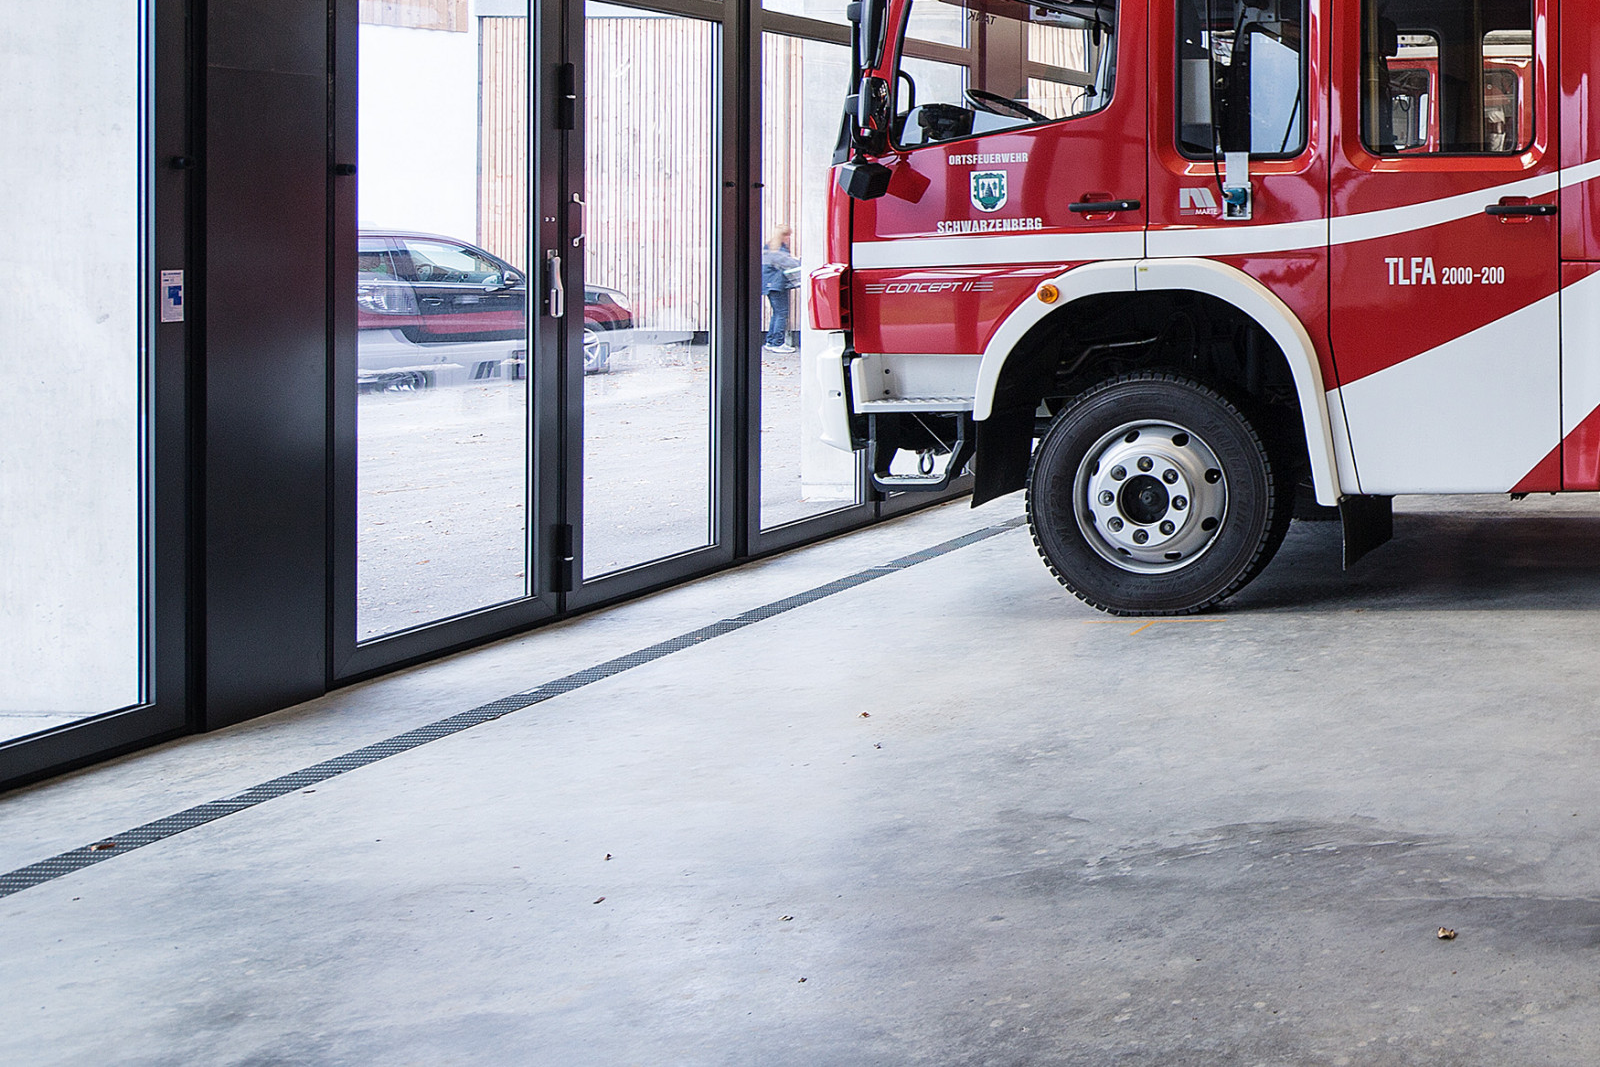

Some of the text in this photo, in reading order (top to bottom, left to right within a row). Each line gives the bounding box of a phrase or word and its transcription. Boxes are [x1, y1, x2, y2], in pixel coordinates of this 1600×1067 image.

[948, 152, 1029, 165] ORTSFEUERWEHR
[936, 217, 1043, 233] SCHWARZENBERG
[1384, 257, 1505, 285] TLFA 2000-200
[885, 282, 963, 293] CONCEPT
